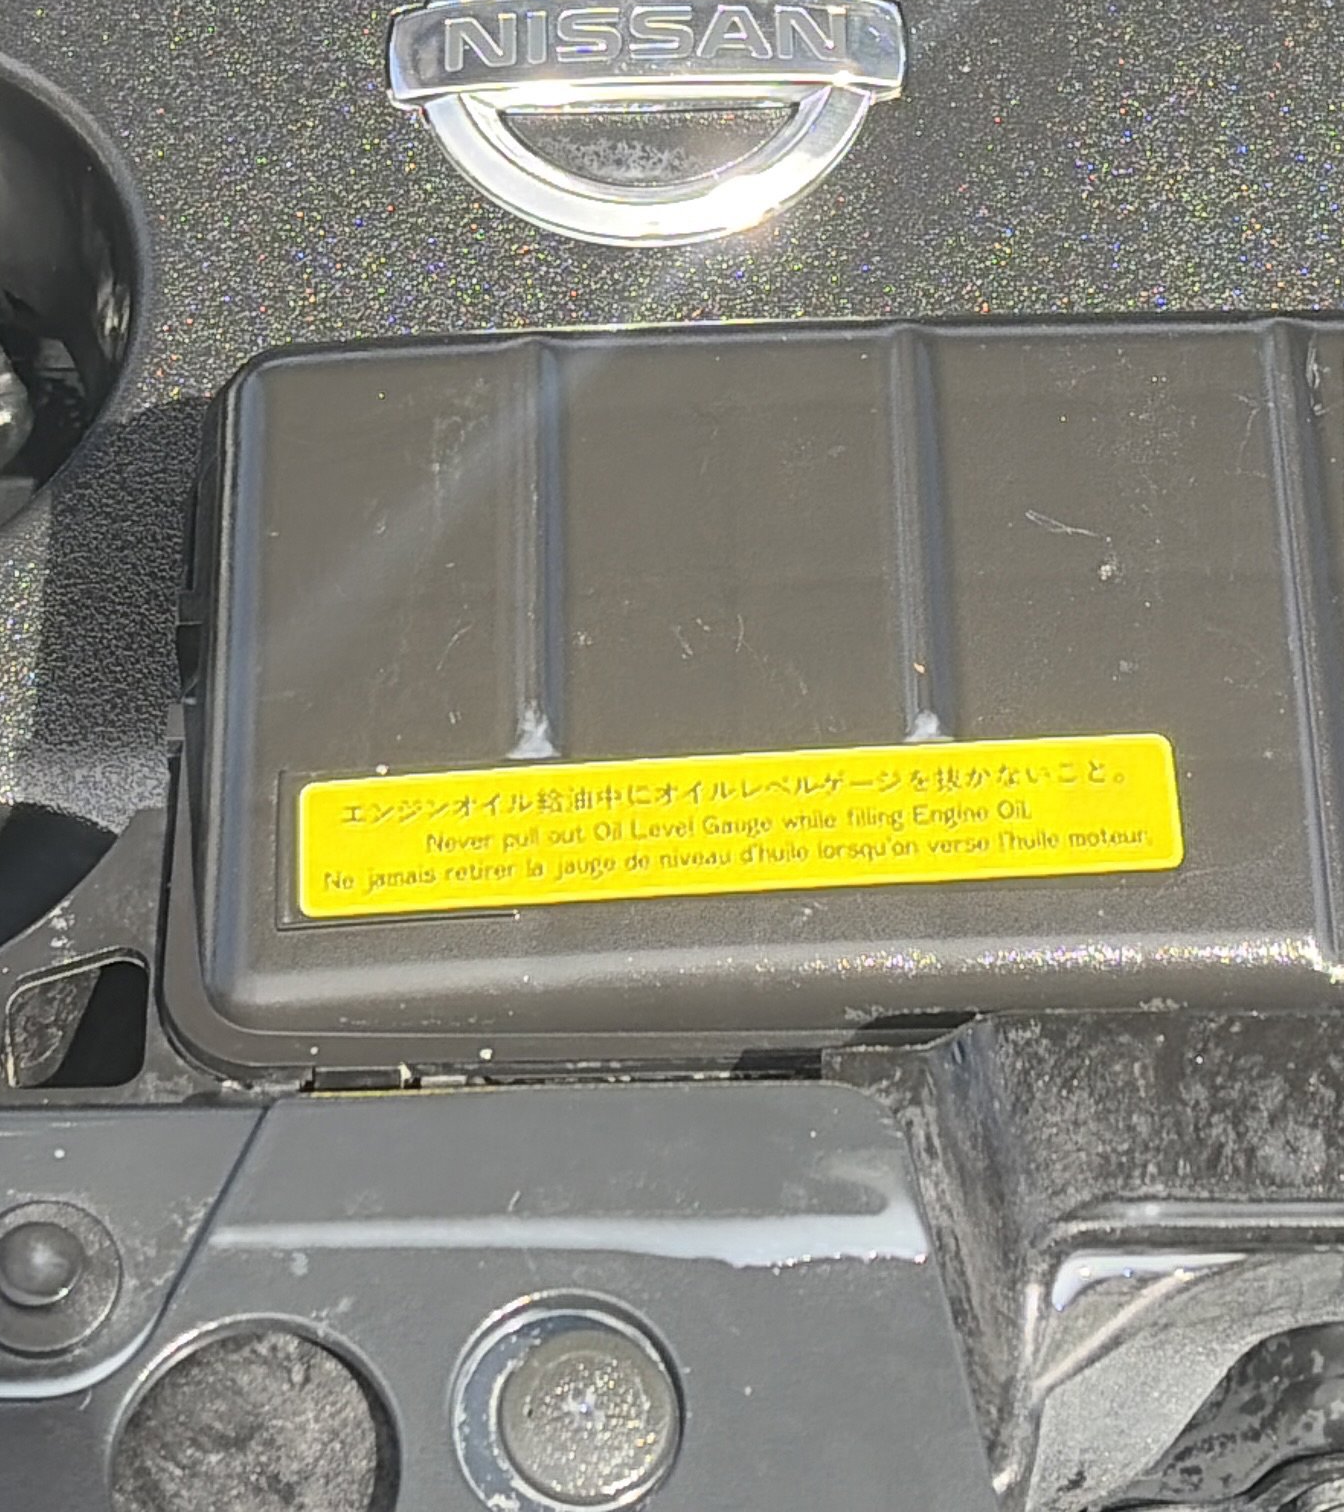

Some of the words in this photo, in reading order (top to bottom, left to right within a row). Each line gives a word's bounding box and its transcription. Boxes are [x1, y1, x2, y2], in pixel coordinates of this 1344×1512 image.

[443, 3, 849, 73] NISSAN
[323, 871, 355, 889] Ne
[364, 863, 437, 895] jamais
[444, 859, 514, 882] retirer
[525, 856, 544, 878] la
[554, 855, 617, 881] jauge
[624, 851, 650, 871] de
[659, 846, 732, 869] niveau
[739, 840, 809, 864] d'huile
[816, 835, 920, 863] lorsqu'on
[928, 836, 990, 854] verse
[997, 829, 1060, 853] l'huile
[1067, 827, 1153, 849] moteur.
[425, 832, 492, 854] Never
[502, 826, 540, 854] pull
[547, 824, 585, 845] out
[593, 820, 623, 842] Oil
[630, 815, 695, 840] Level
[702, 814, 773, 839] Gauge
[781, 807, 837, 830] while
[846, 806, 905, 832] filling
[912, 801, 989, 830] Engine
